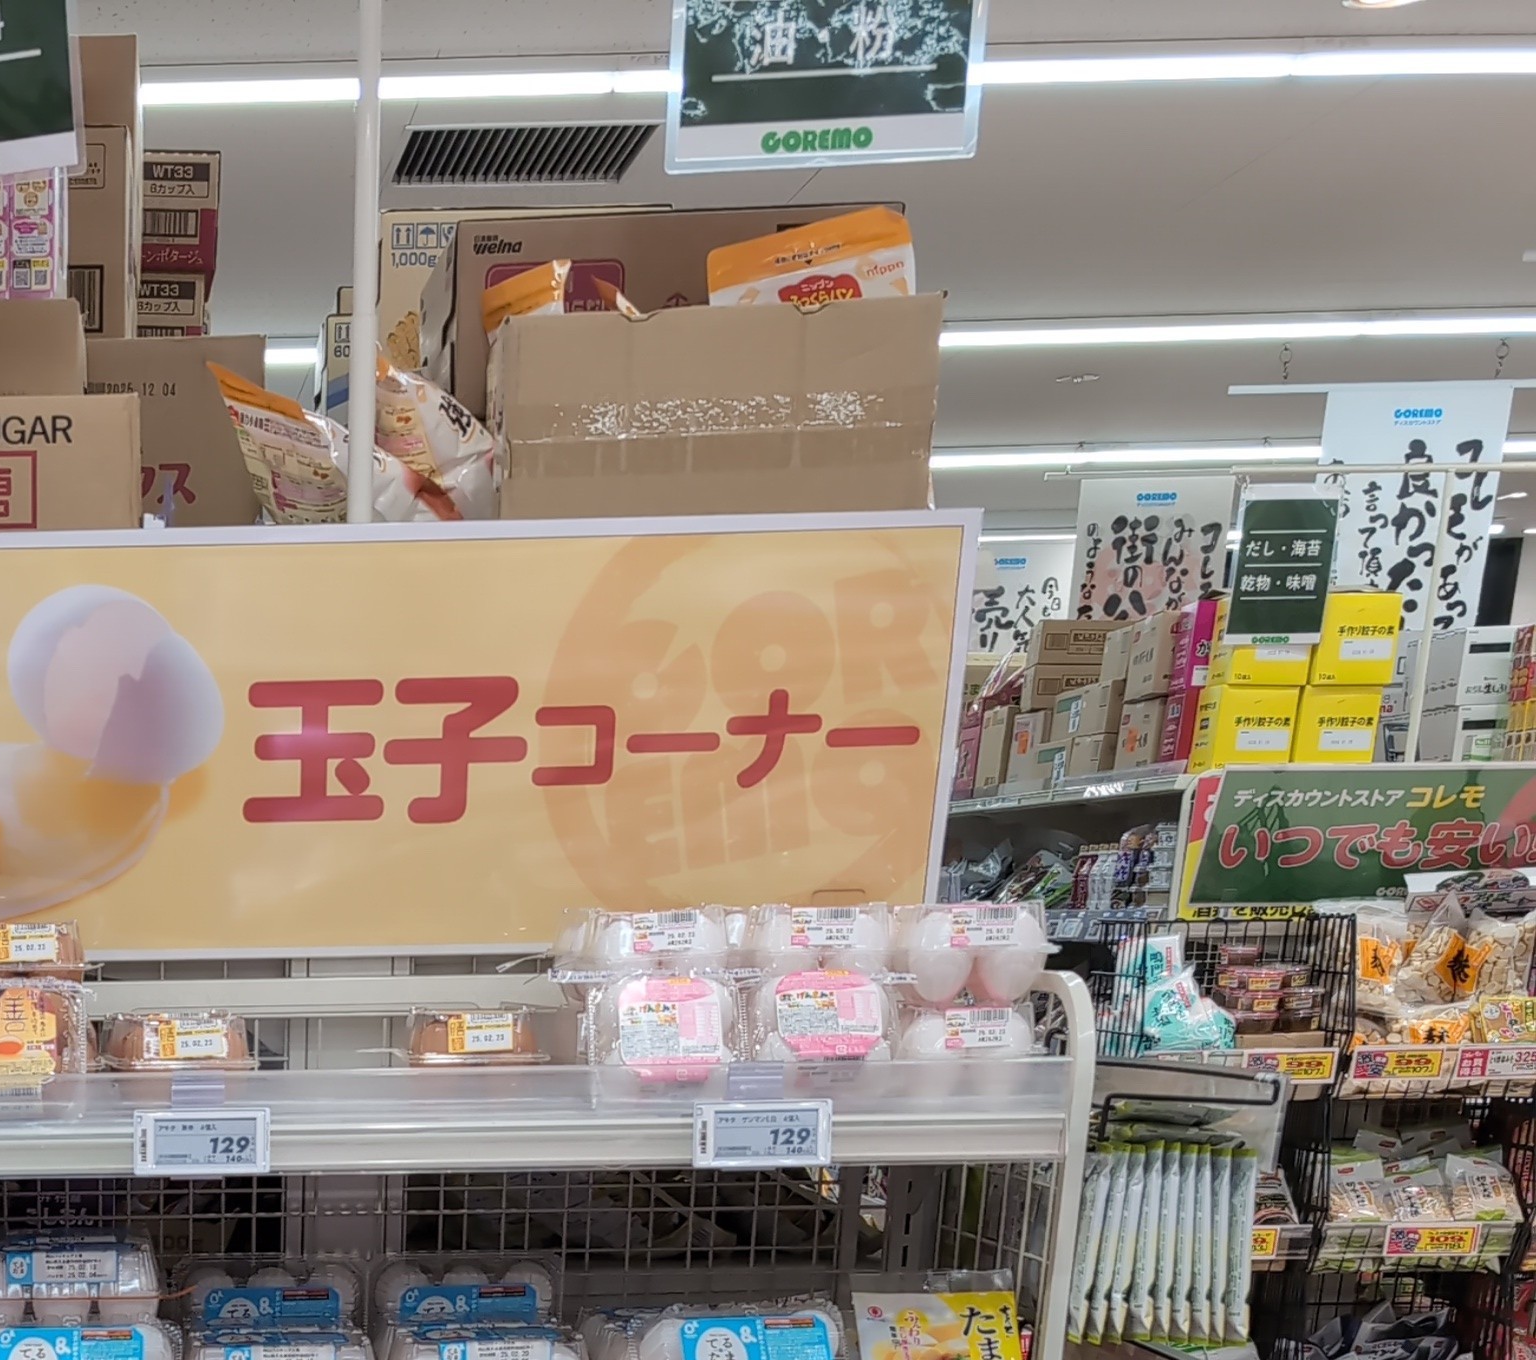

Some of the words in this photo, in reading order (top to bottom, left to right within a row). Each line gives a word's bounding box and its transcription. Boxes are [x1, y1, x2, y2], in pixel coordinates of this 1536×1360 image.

[152, 163, 194, 179] WT33
[149, 183, 195, 195] 6カップ入
[391, 252, 437, 268] 1,000g
[1337, 625, 1395, 637] 手作り餃子の素
[1234, 716, 1291, 727] 手作り餃子の素
[1317, 716, 1374, 727] 手作り餃子の素
[242, 675, 921, 824] 玉子コーナー
[1233, 787, 1405, 808] ディスカウントストア
[1406, 784, 1486, 809] コレモ
[769, 1127, 812, 1145] 129
[209, 1136, 251, 1154] 129
